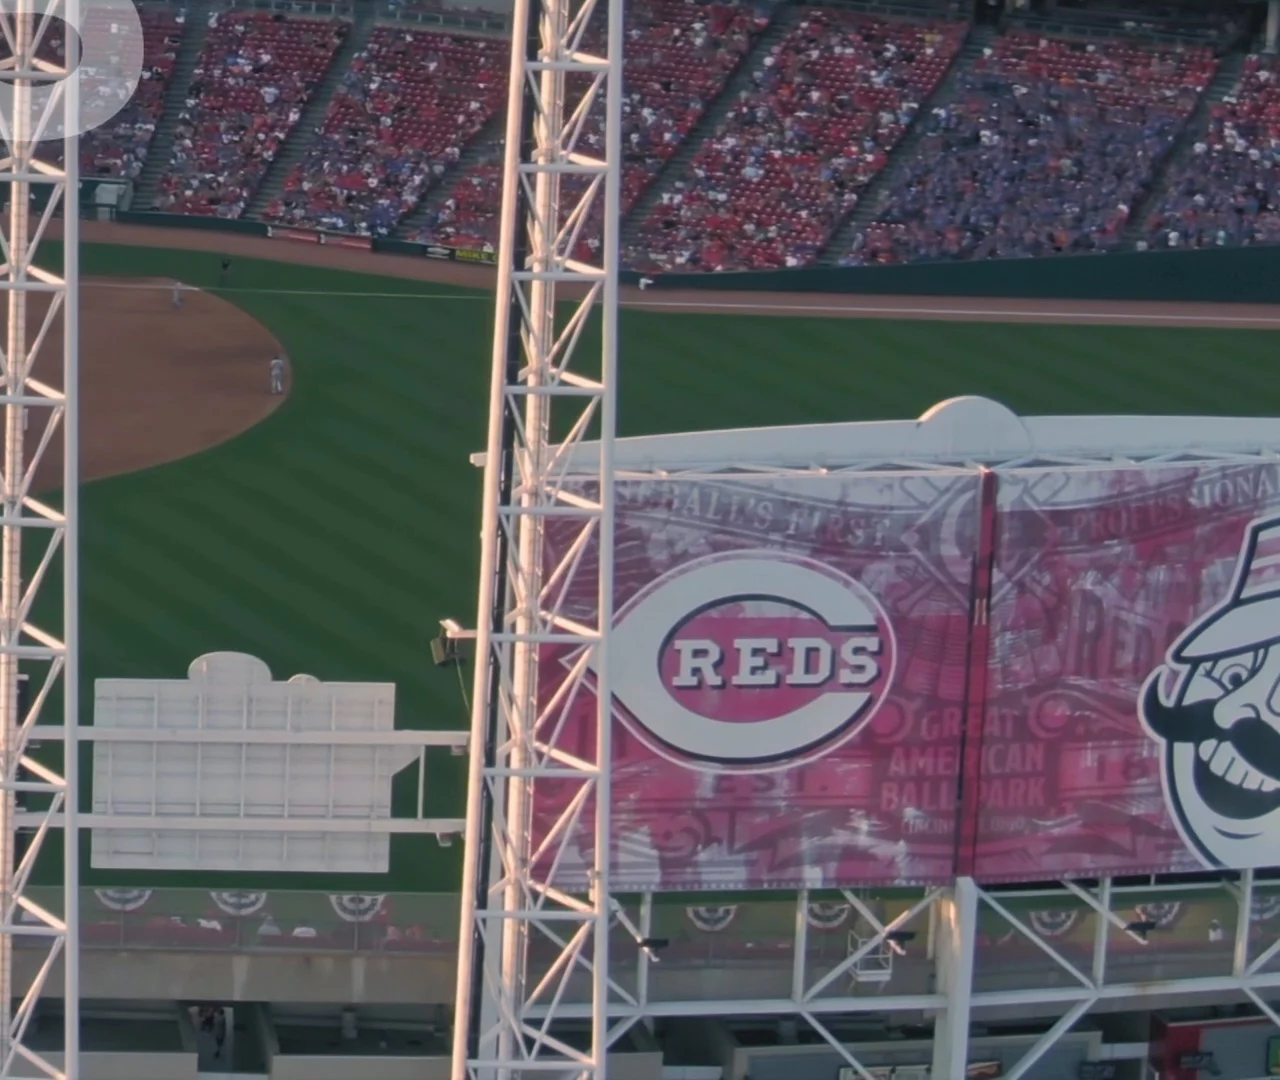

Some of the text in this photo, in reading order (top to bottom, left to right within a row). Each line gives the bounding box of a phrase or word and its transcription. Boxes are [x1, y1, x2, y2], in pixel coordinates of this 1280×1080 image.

[1072, 465, 1280, 542] PROFESSIONA
[671, 636, 883, 690] REDS
[919, 704, 1019, 742] GREAT
[887, 743, 1046, 776] AMERICAN
